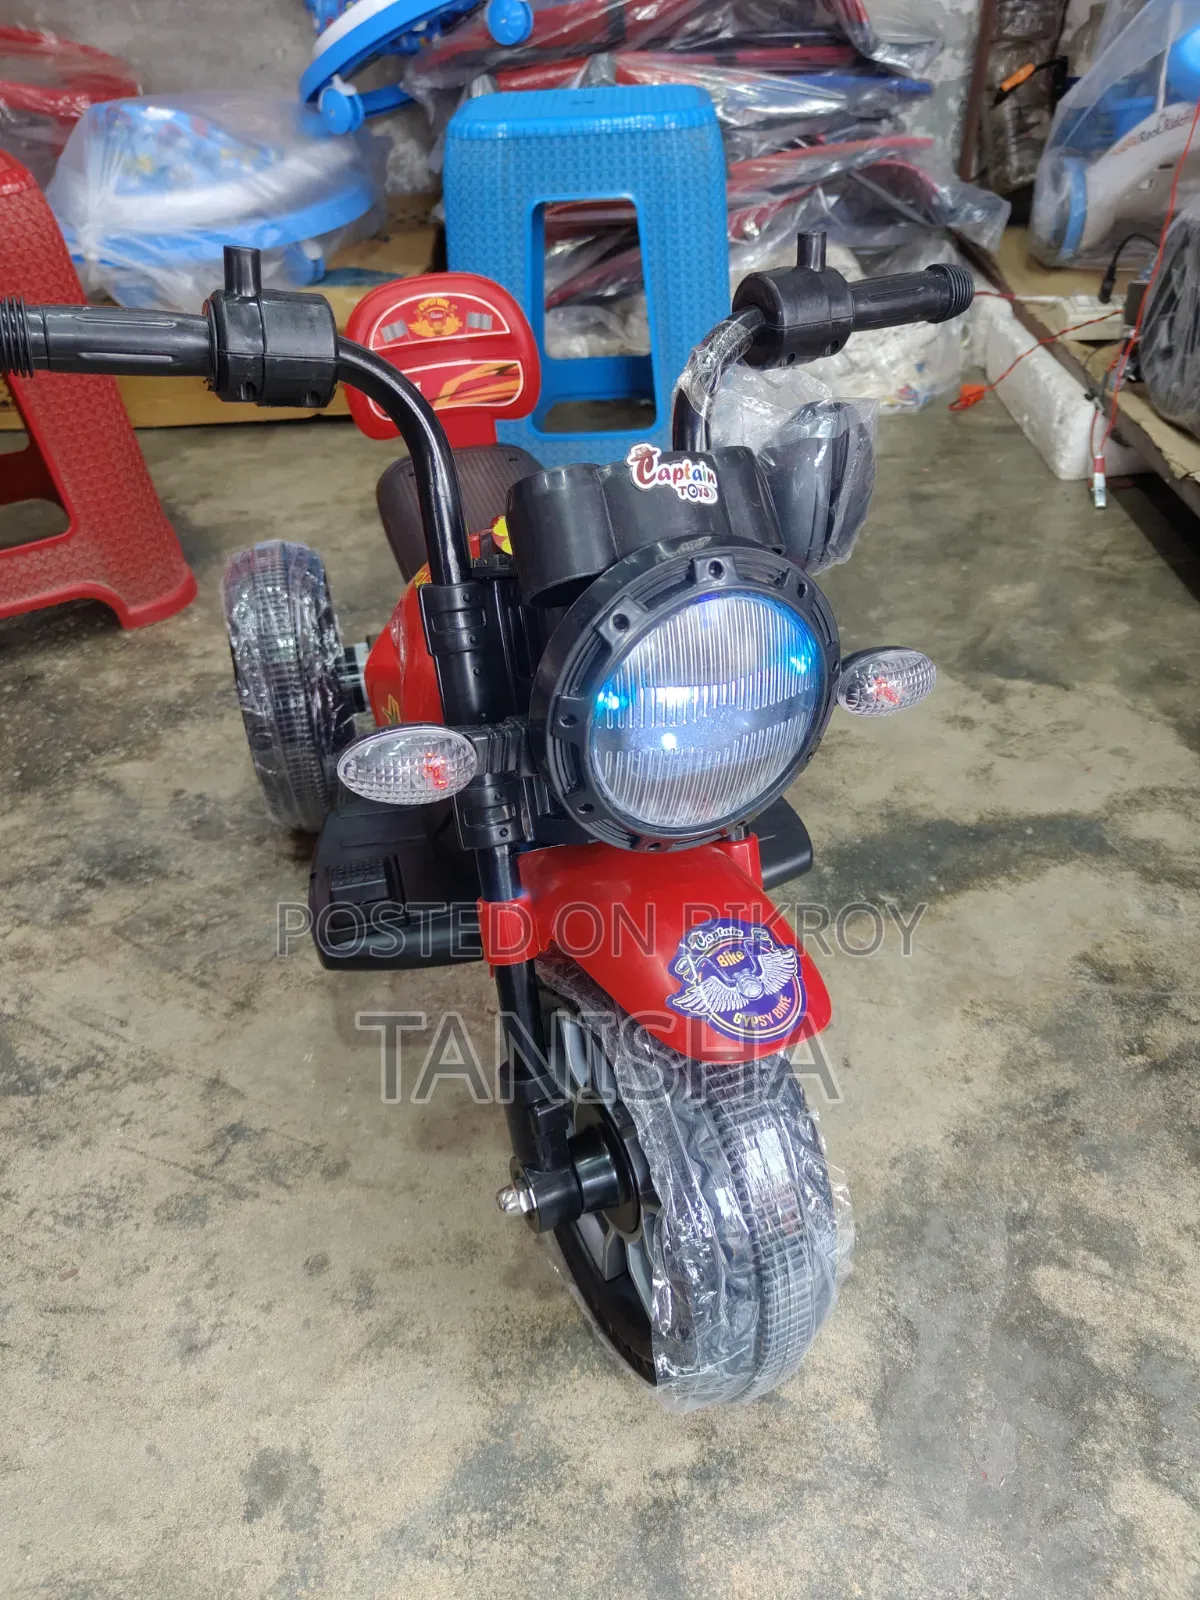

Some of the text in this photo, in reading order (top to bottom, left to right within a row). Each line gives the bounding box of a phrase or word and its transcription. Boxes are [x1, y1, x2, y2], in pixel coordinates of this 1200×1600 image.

[633, 448, 716, 486] Captain
[677, 484, 710, 499] TOYS
[688, 926, 744, 951] Captain
[716, 950, 745, 968] Bike
[733, 995, 792, 1028] GYPSY BIKE
